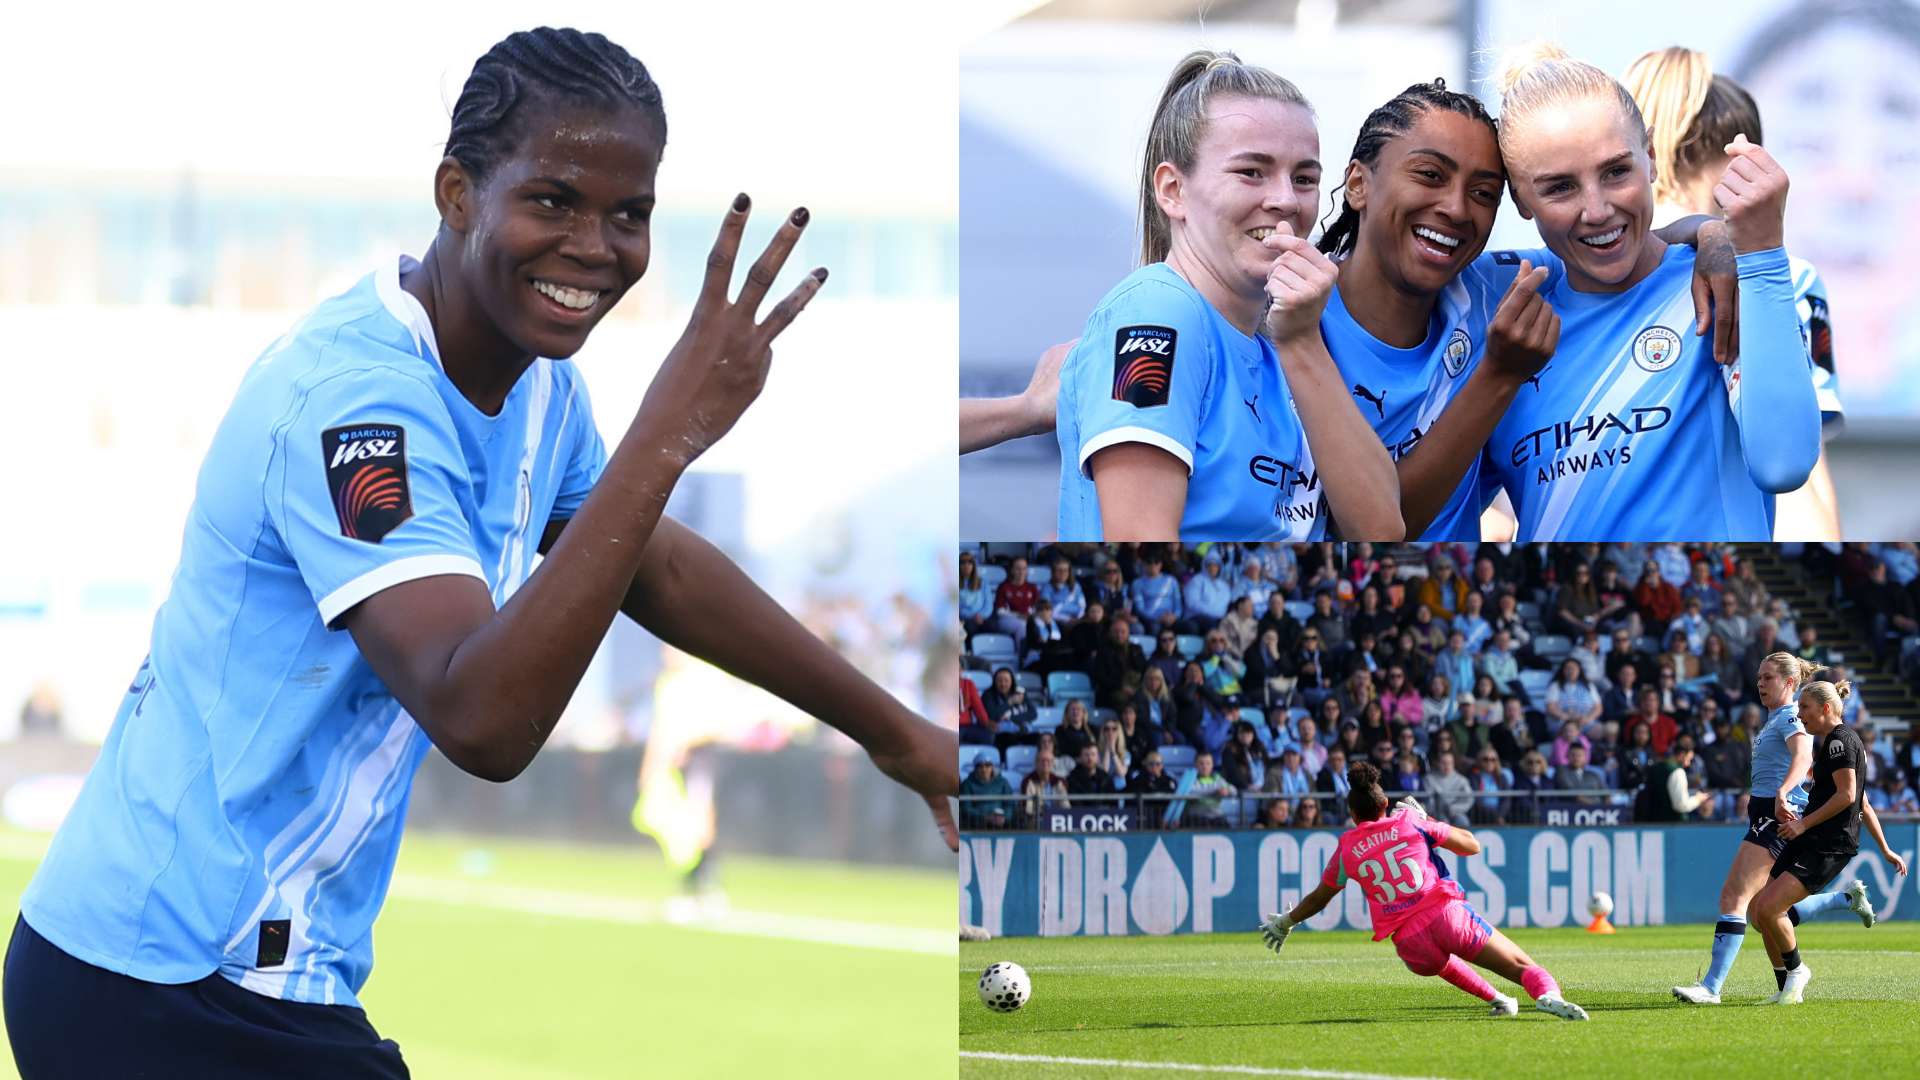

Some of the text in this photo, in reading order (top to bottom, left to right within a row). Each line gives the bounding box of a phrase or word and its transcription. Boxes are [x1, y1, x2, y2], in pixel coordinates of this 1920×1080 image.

[1118, 337, 1171, 356] WSL
[1137, 330, 1171, 339] BARCLAYS
[350, 429, 398, 440] BARCLAYS
[1511, 406, 1672, 467] ETIHAD
[330, 439, 399, 469] WSL
[1537, 446, 1632, 485] AIRWAYS
[1351, 827, 1399, 858] KEATING
[1358, 841, 1424, 904] 35
